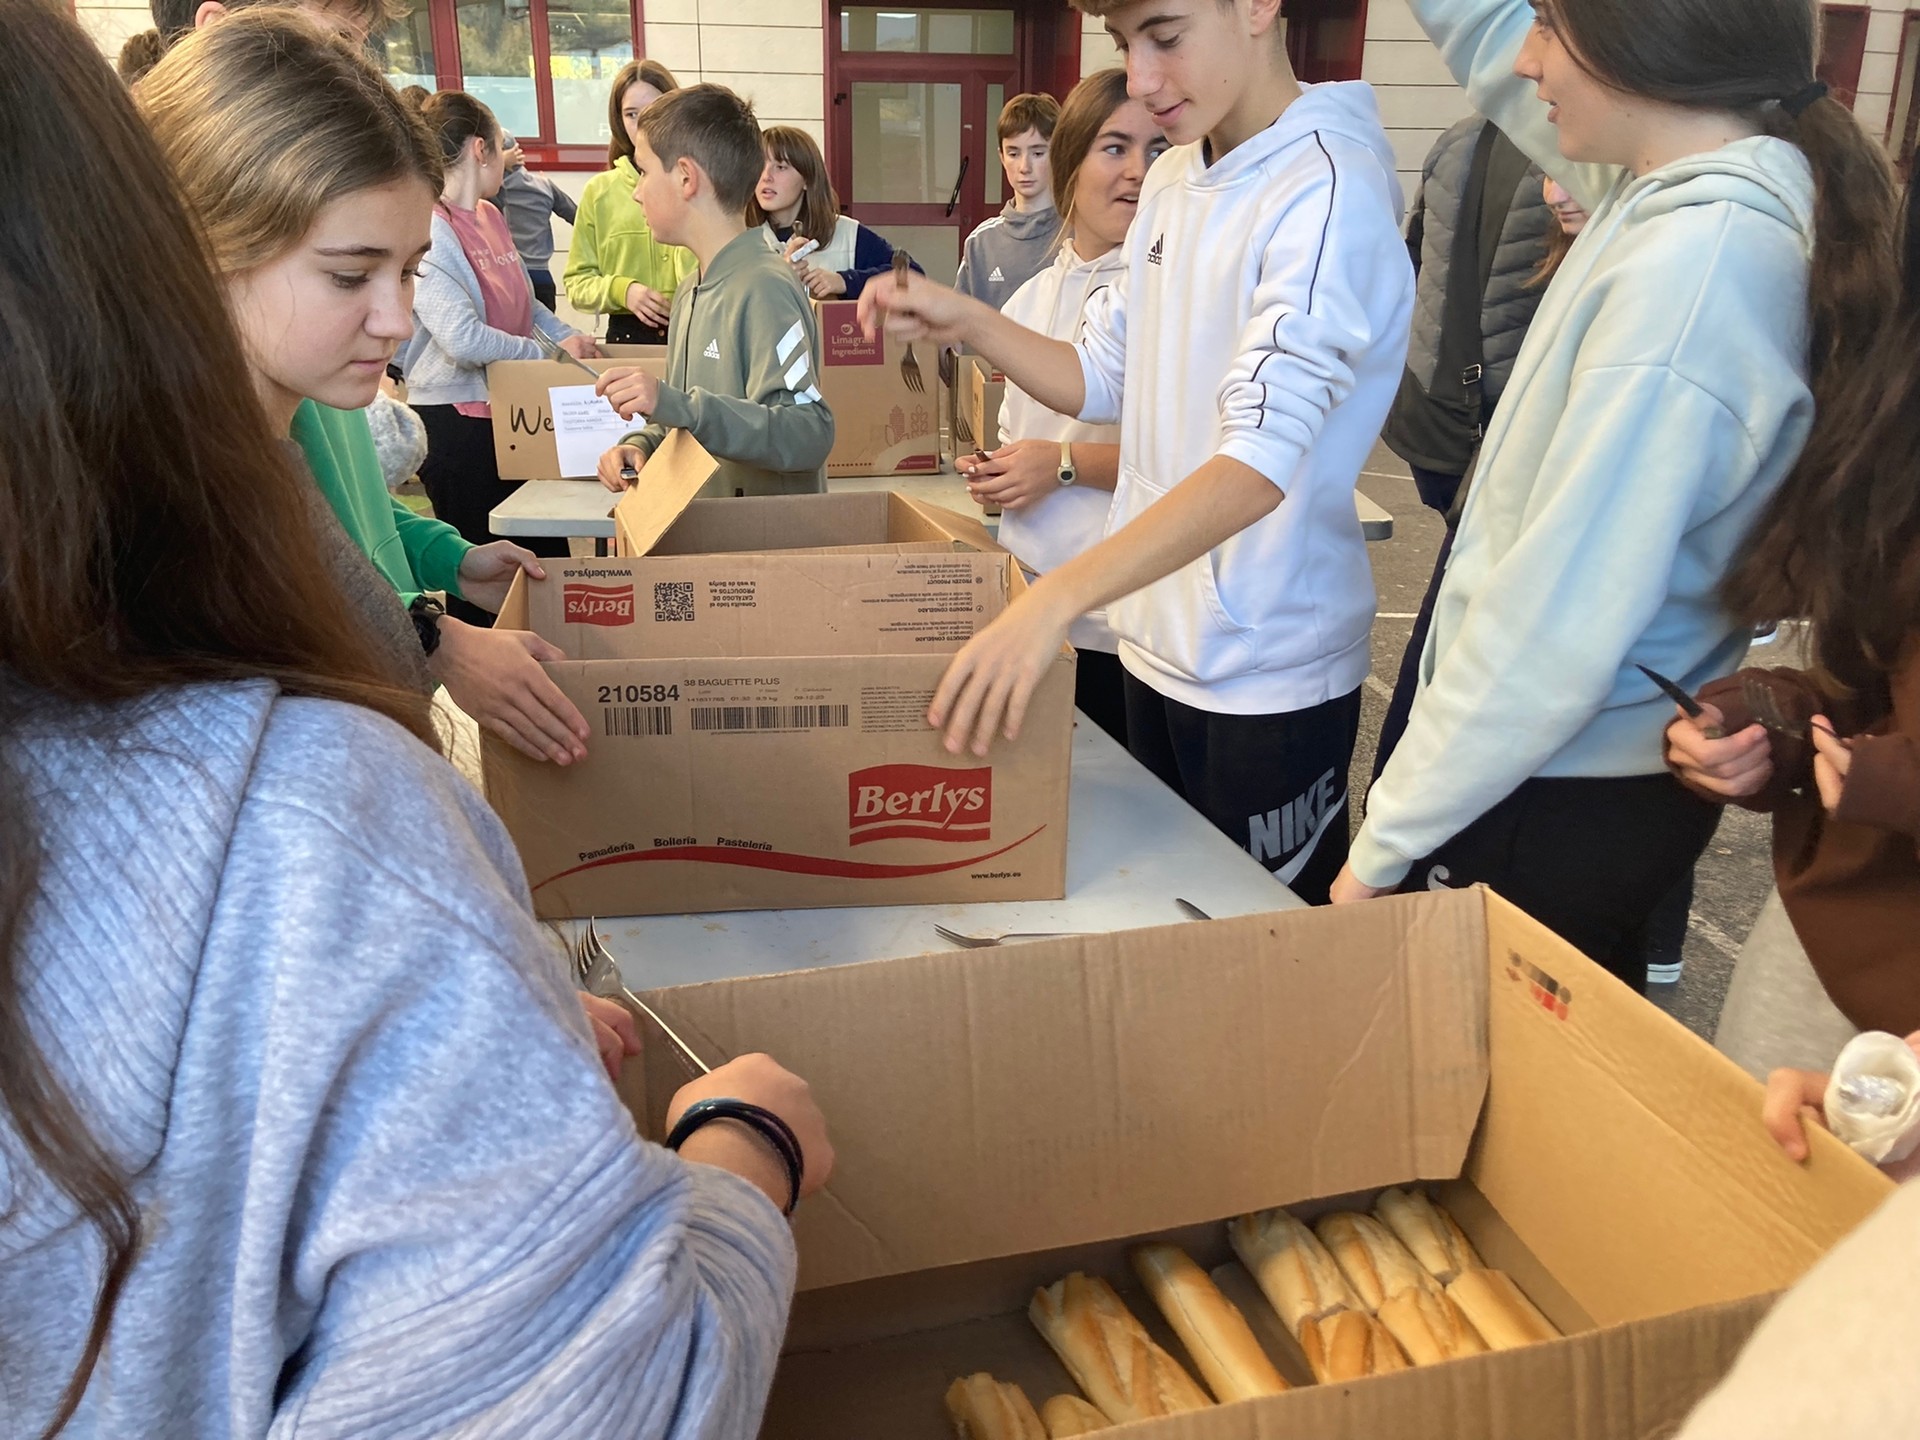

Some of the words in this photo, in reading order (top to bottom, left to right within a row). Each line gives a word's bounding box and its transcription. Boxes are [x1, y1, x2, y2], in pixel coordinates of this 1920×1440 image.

[703, 350, 720, 360] adidas
[831, 347, 876, 358] Ingredients
[563, 568, 633, 579] www.berlys.es
[567, 591, 633, 618] Berlys
[683, 679, 696, 687] 38
[698, 677, 752, 687] BAGUETTE
[754, 677, 780, 686] PLUS
[597, 684, 680, 704] 210584
[853, 781, 986, 830] Berlys
[1248, 766, 1336, 863] NIKE
[578, 841, 636, 862] Panadería
[653, 836, 697, 848] Bollería
[716, 836, 773, 852] Pastelería
